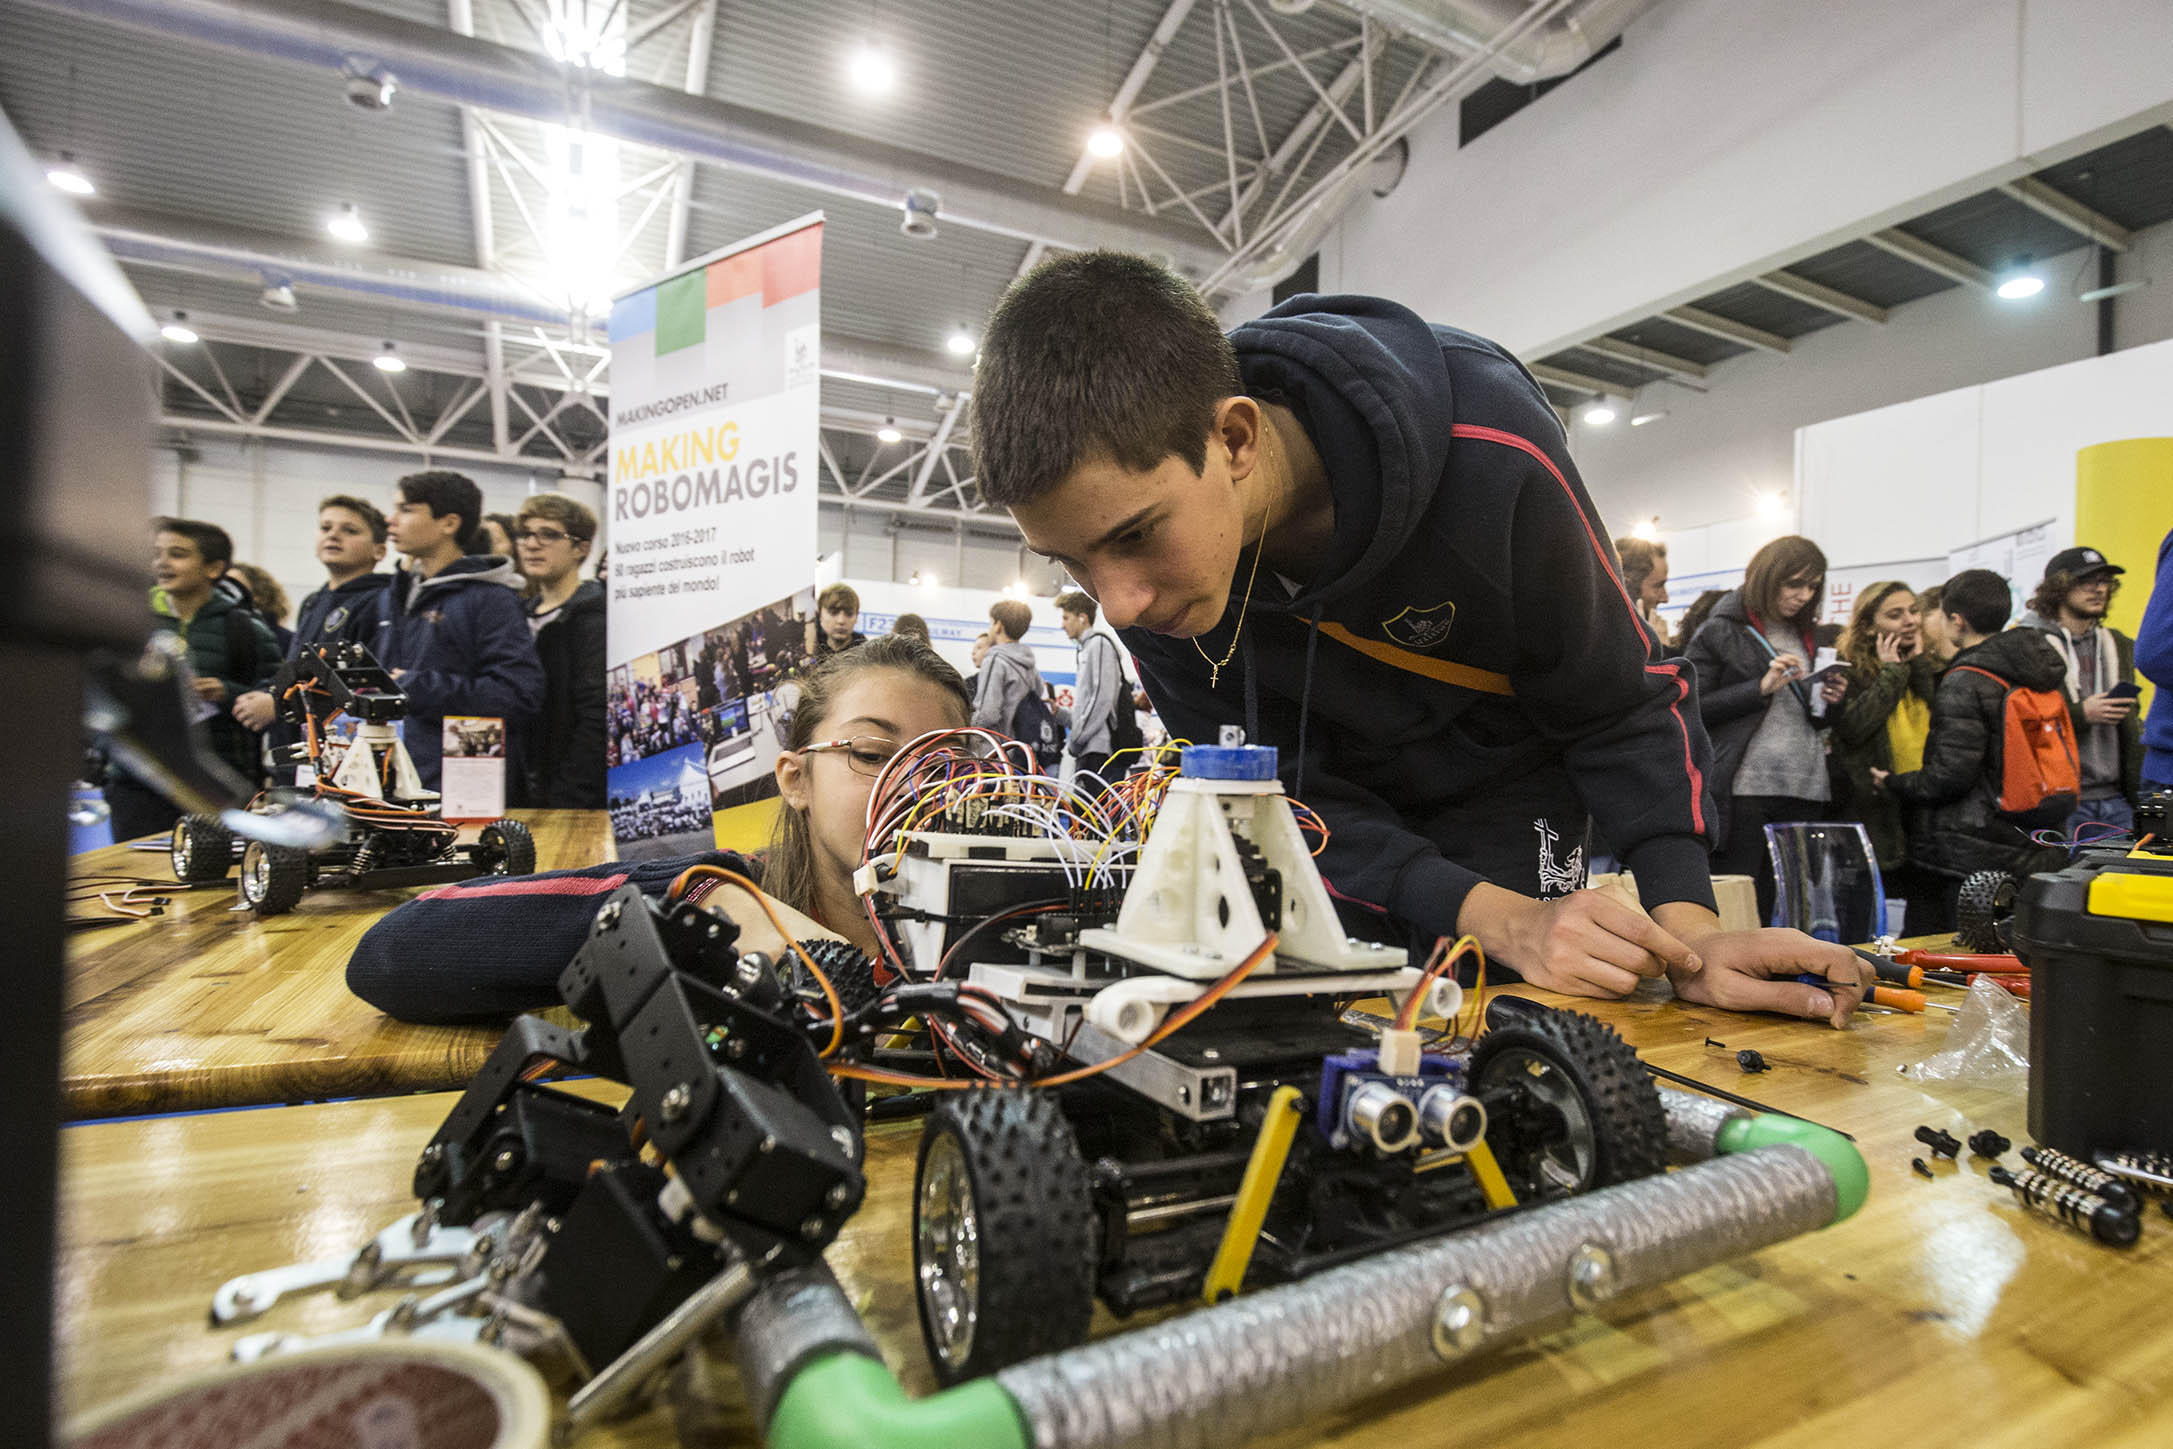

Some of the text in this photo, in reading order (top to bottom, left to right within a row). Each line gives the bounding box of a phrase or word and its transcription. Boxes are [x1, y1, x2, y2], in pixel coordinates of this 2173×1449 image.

[617, 383, 728, 425] MAKINGOPEN.NET
[616, 421, 740, 484] MAKING
[615, 451, 797, 521] ROBOMAGIS
[643, 538, 668, 551] corso
[729, 547, 754, 563] robot
